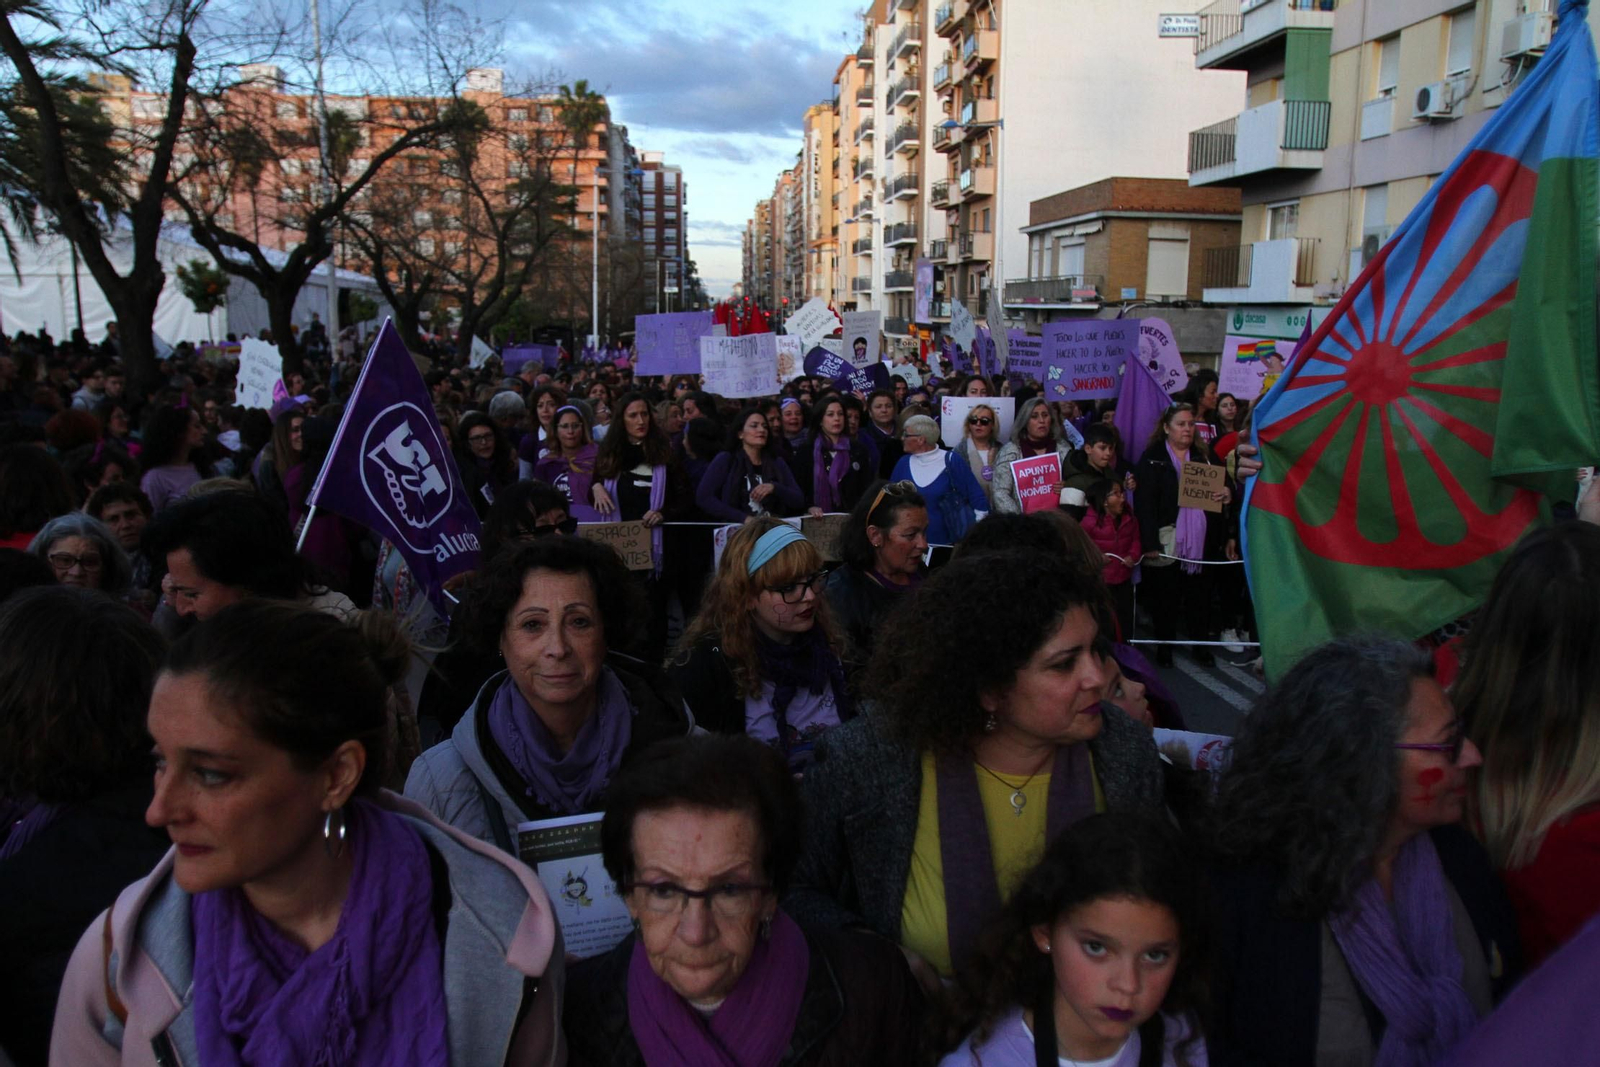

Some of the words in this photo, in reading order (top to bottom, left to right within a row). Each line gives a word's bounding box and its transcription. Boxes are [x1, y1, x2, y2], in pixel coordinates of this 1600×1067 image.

[1140, 326, 1169, 347] FUERTES
[1056, 348, 1077, 359] HACER
[1074, 363, 1098, 374] HACER
[1071, 376, 1115, 393] SANGRANDO
[1019, 464, 1057, 479] APUNTA
[1033, 476, 1044, 486] MI
[1182, 486, 1216, 501] AUSENTE
[586, 525, 641, 542] ESPACIO
[622, 539, 638, 548] LAS
